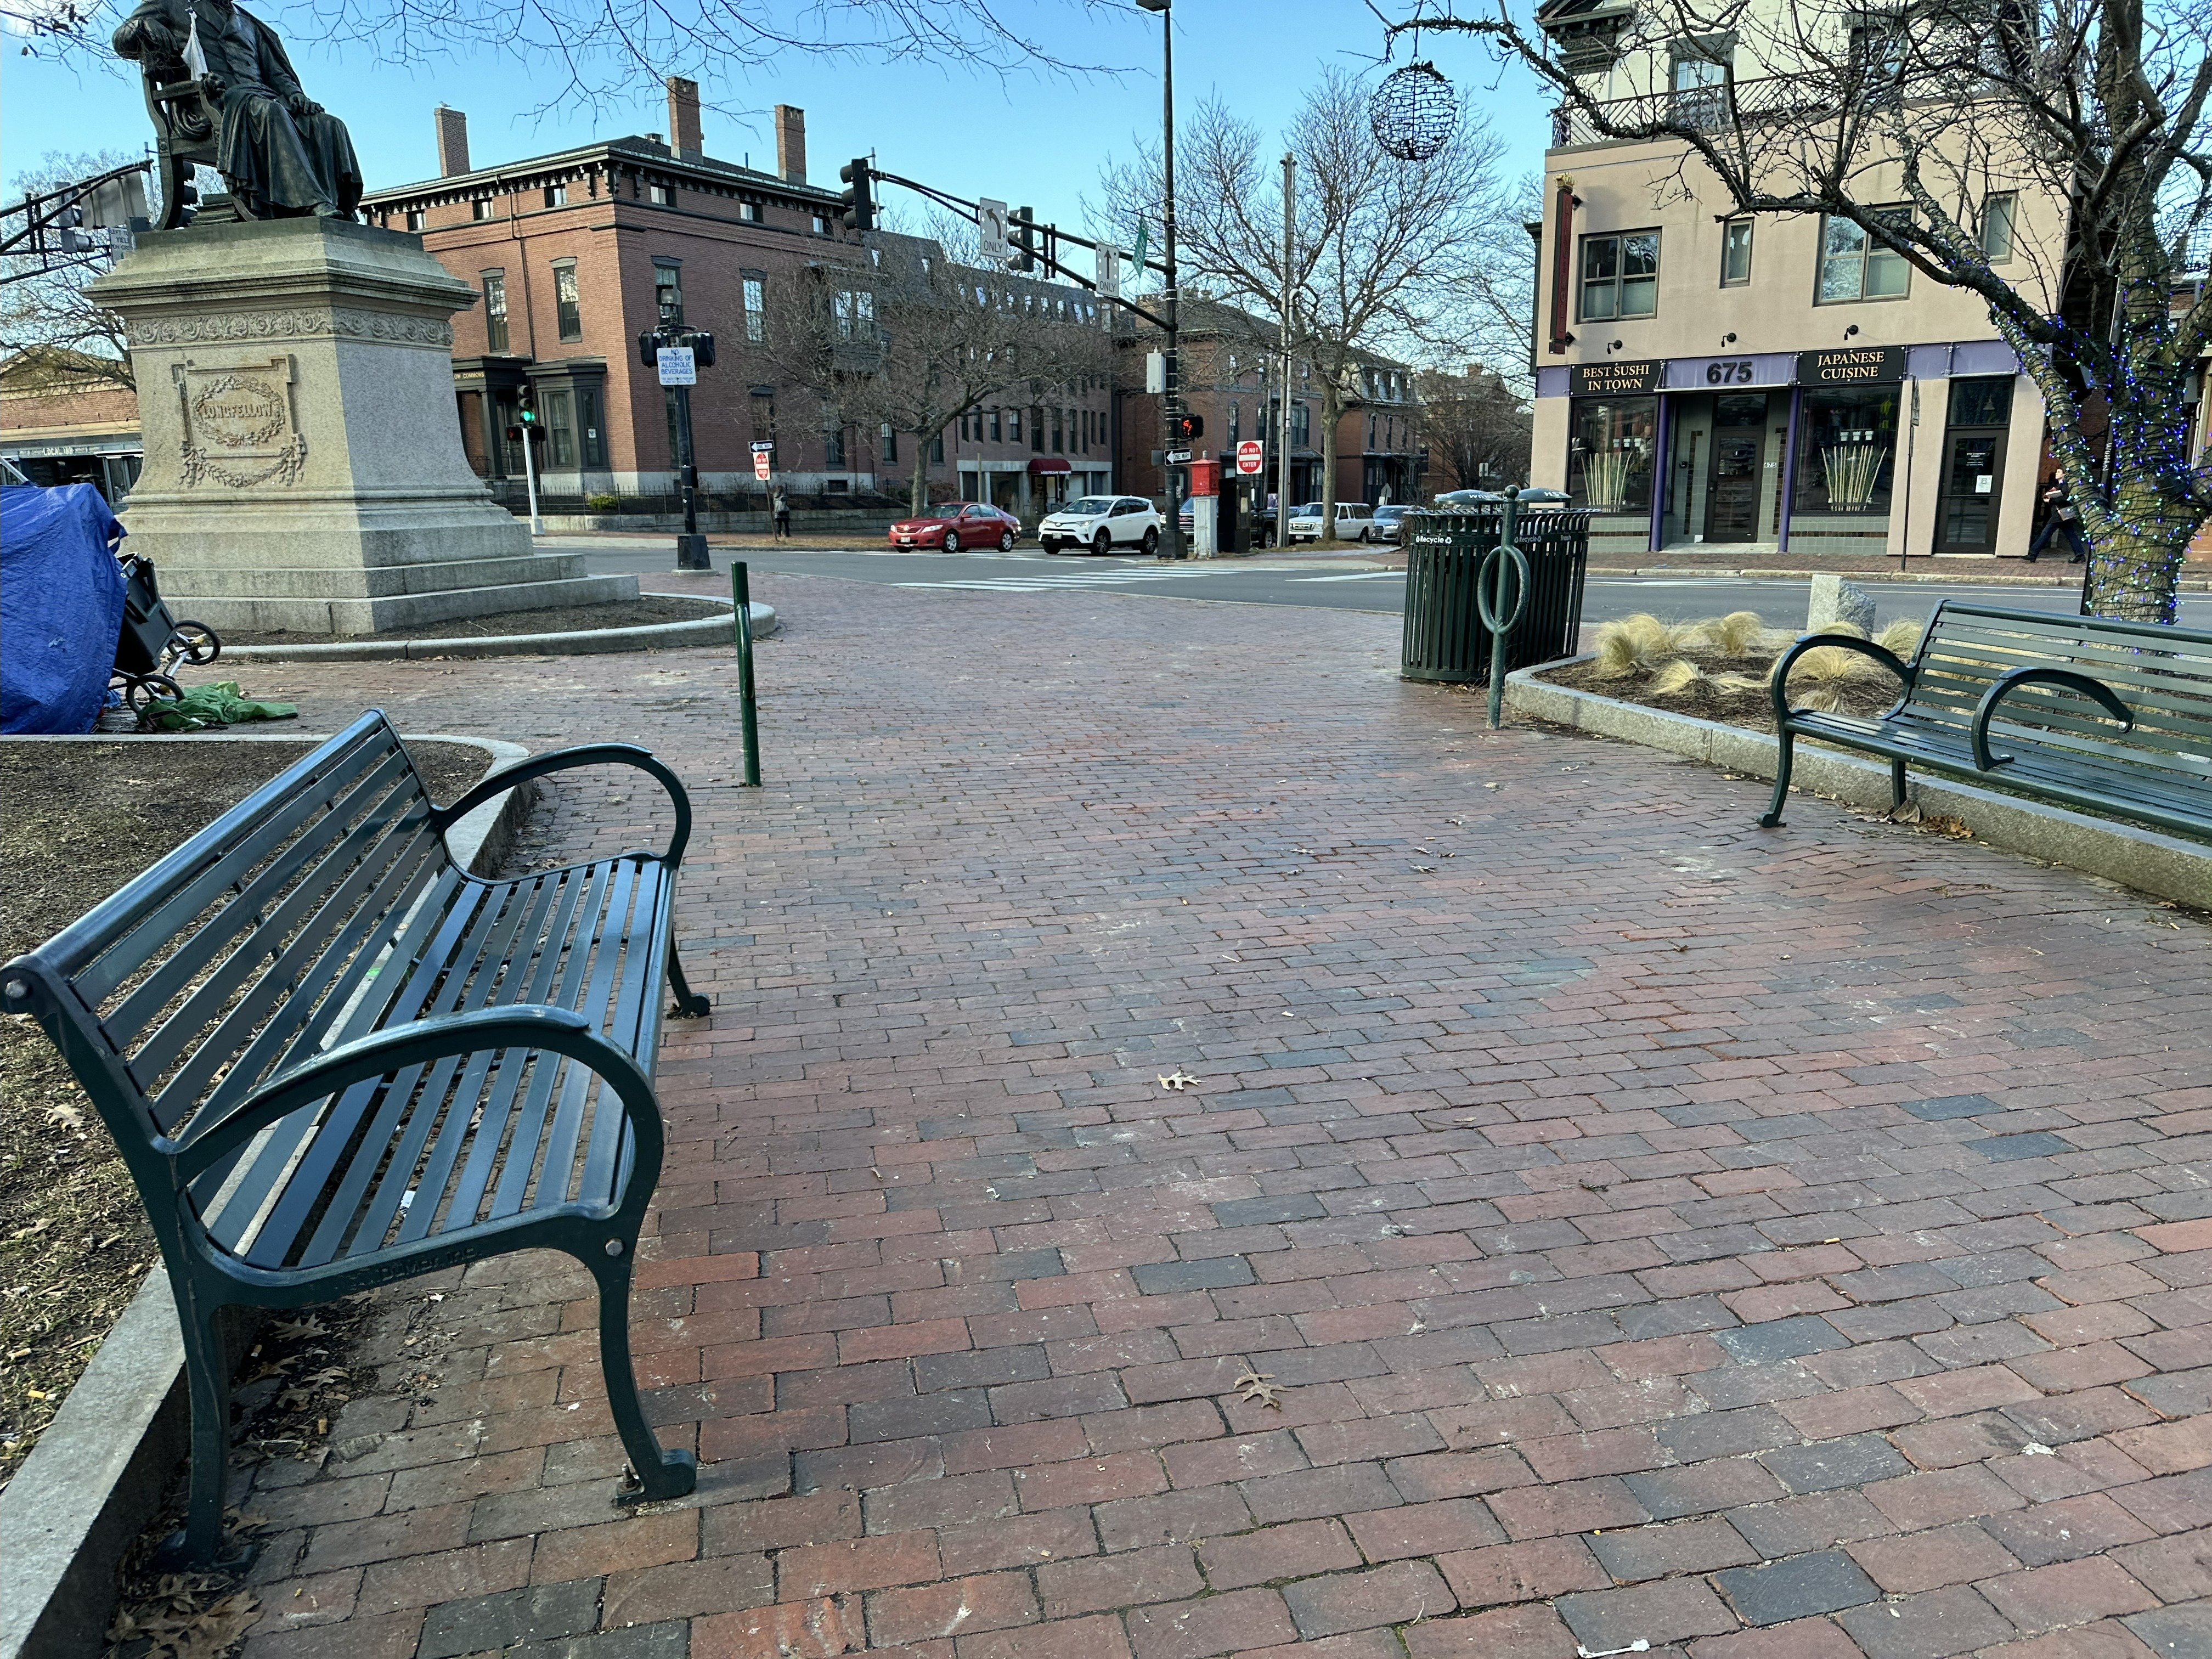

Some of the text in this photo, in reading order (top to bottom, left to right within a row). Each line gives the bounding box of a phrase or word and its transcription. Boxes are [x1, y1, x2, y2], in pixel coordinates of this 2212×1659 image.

[984, 240, 1003, 253] ONLY
[1099, 280, 1116, 292] ONLY
[1816, 352, 1884, 368] JAPANESE
[1583, 364, 1650, 378] BEST SUSHI
[1707, 361, 1752, 383] 675
[1821, 366, 1878, 380] CUISINE
[1587, 378, 1644, 391] IN TOWN
[201, 404, 272, 419] LONGFELLOW
[43, 447, 63, 456] LOCAL
[1420, 535, 1444, 544] Recycle
[1519, 535, 1537, 544] Recycle
